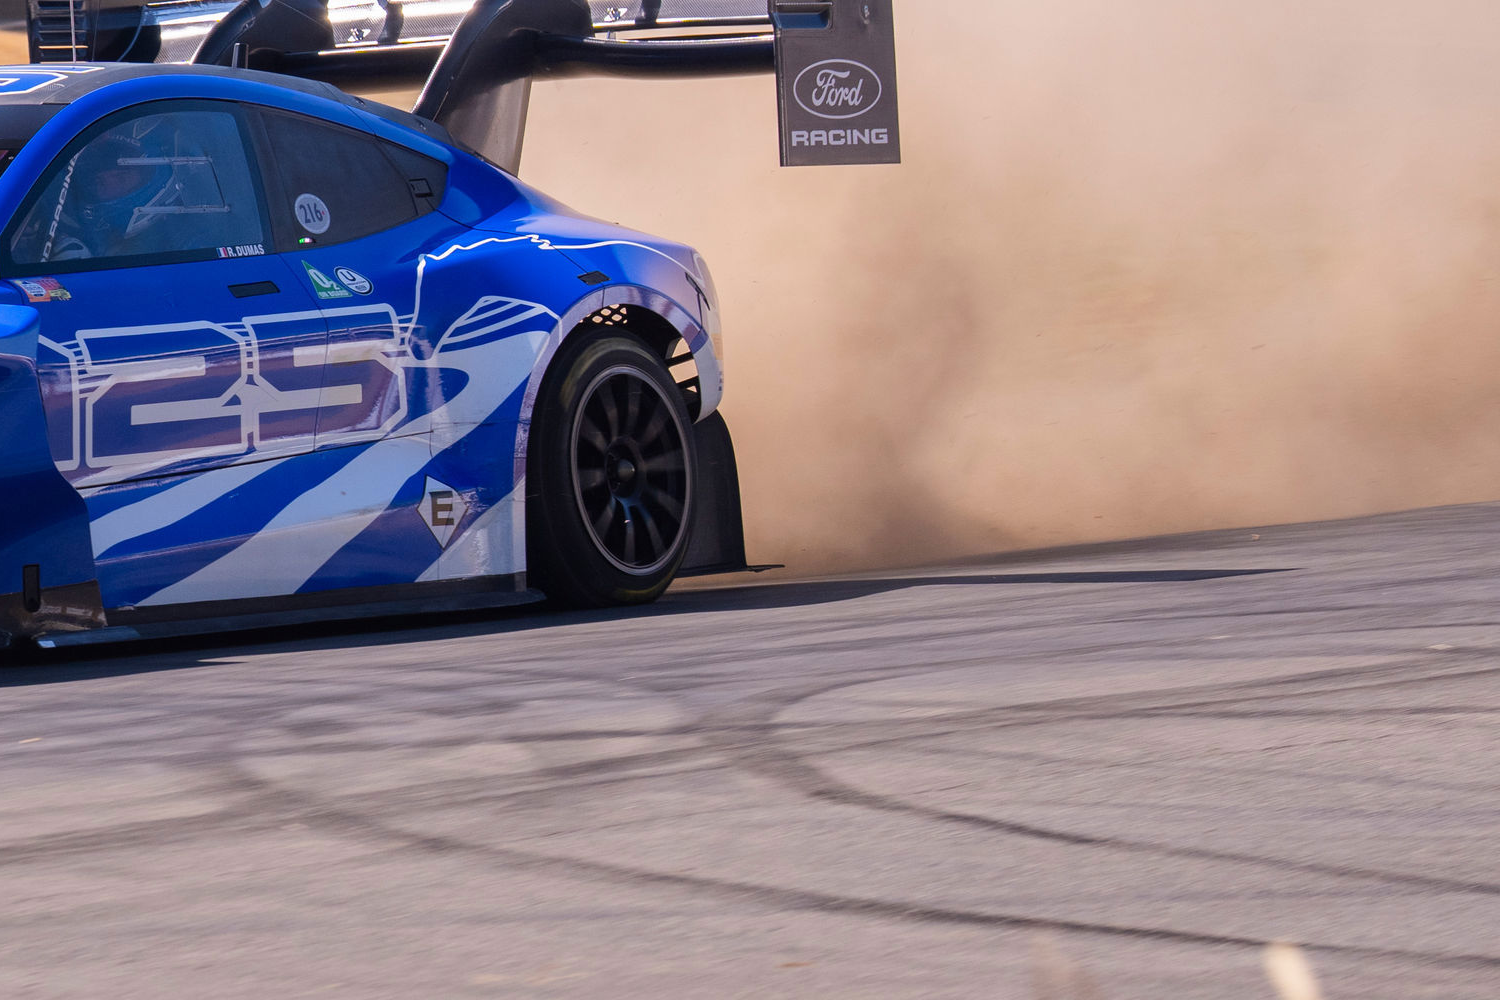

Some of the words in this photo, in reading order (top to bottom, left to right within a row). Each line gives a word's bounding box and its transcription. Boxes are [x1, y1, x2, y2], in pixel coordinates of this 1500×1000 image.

[812, 69, 864, 107] Ford
[791, 128, 888, 147] RACING
[299, 203, 324, 224] 216
[235, 244, 265, 257] DUMAS
[428, 490, 455, 527] E
